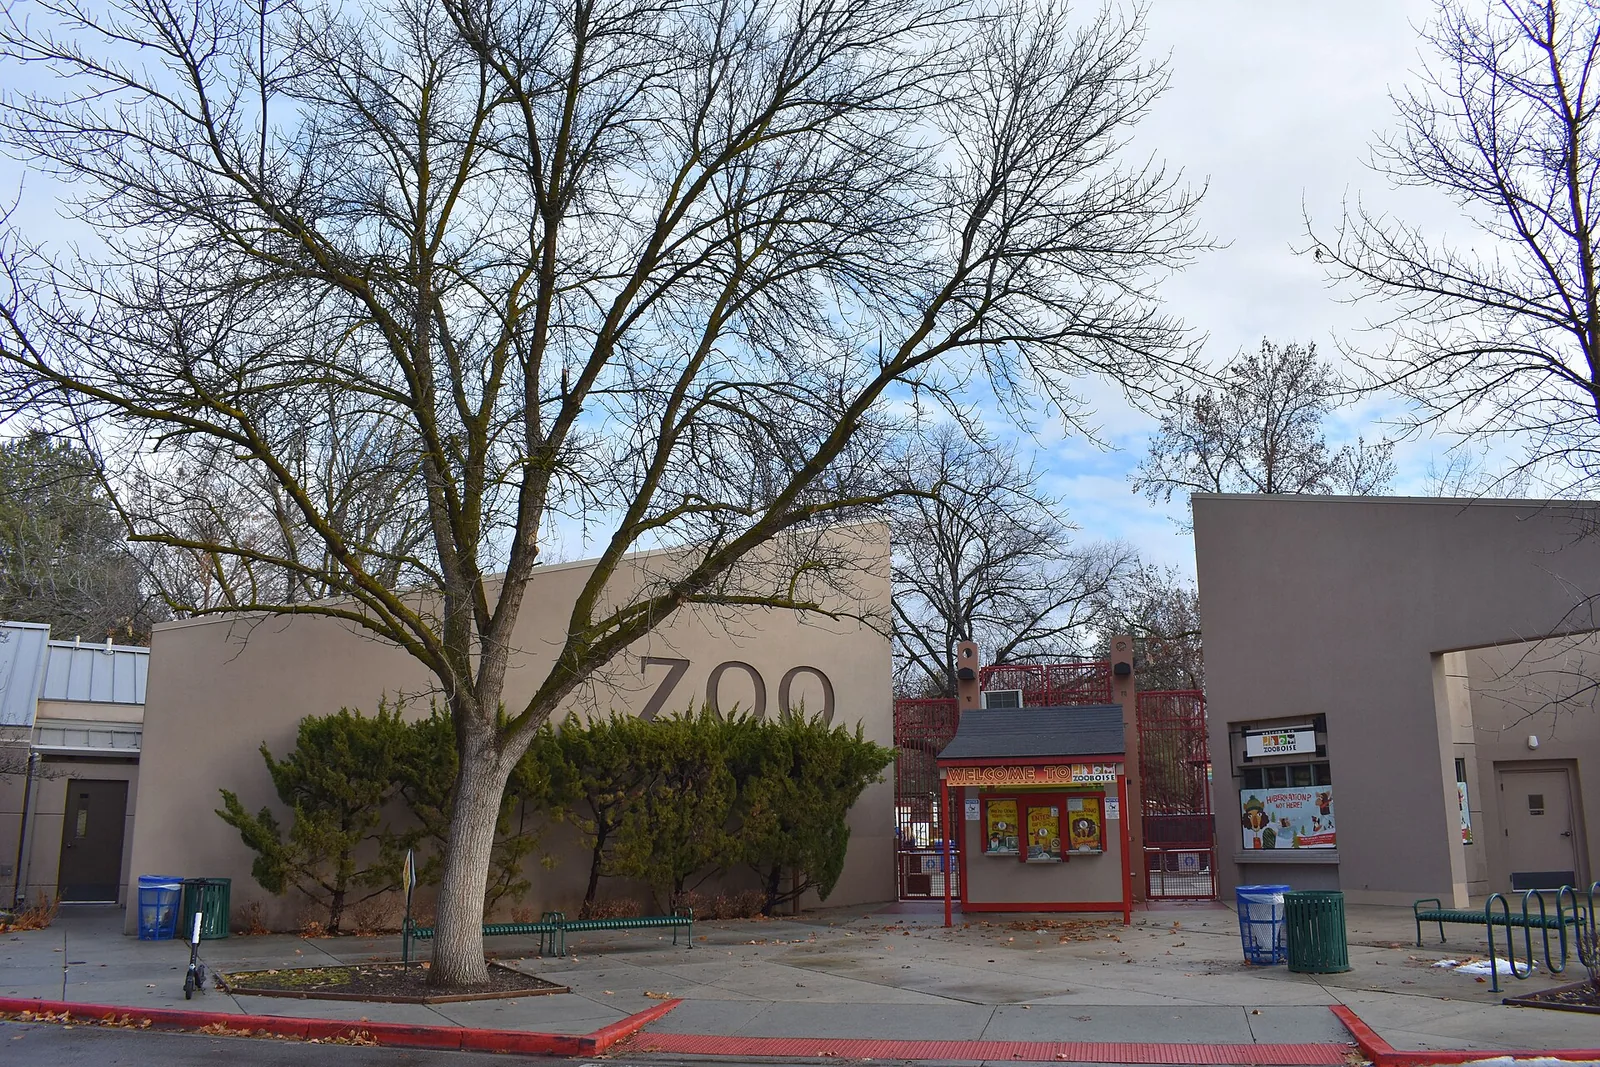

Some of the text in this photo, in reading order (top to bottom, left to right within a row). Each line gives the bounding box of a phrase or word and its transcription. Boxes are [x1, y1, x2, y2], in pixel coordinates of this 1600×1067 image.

[638, 656, 836, 727] ZOO
[1263, 745, 1297, 753] ZOOBOISE
[947, 765, 1071, 781] WELCOME TO
[1072, 774, 1115, 782] ZOOBOISE
[1265, 793, 1312, 804] HIBERNATION?
[1286, 801, 1303, 809] HERE!
